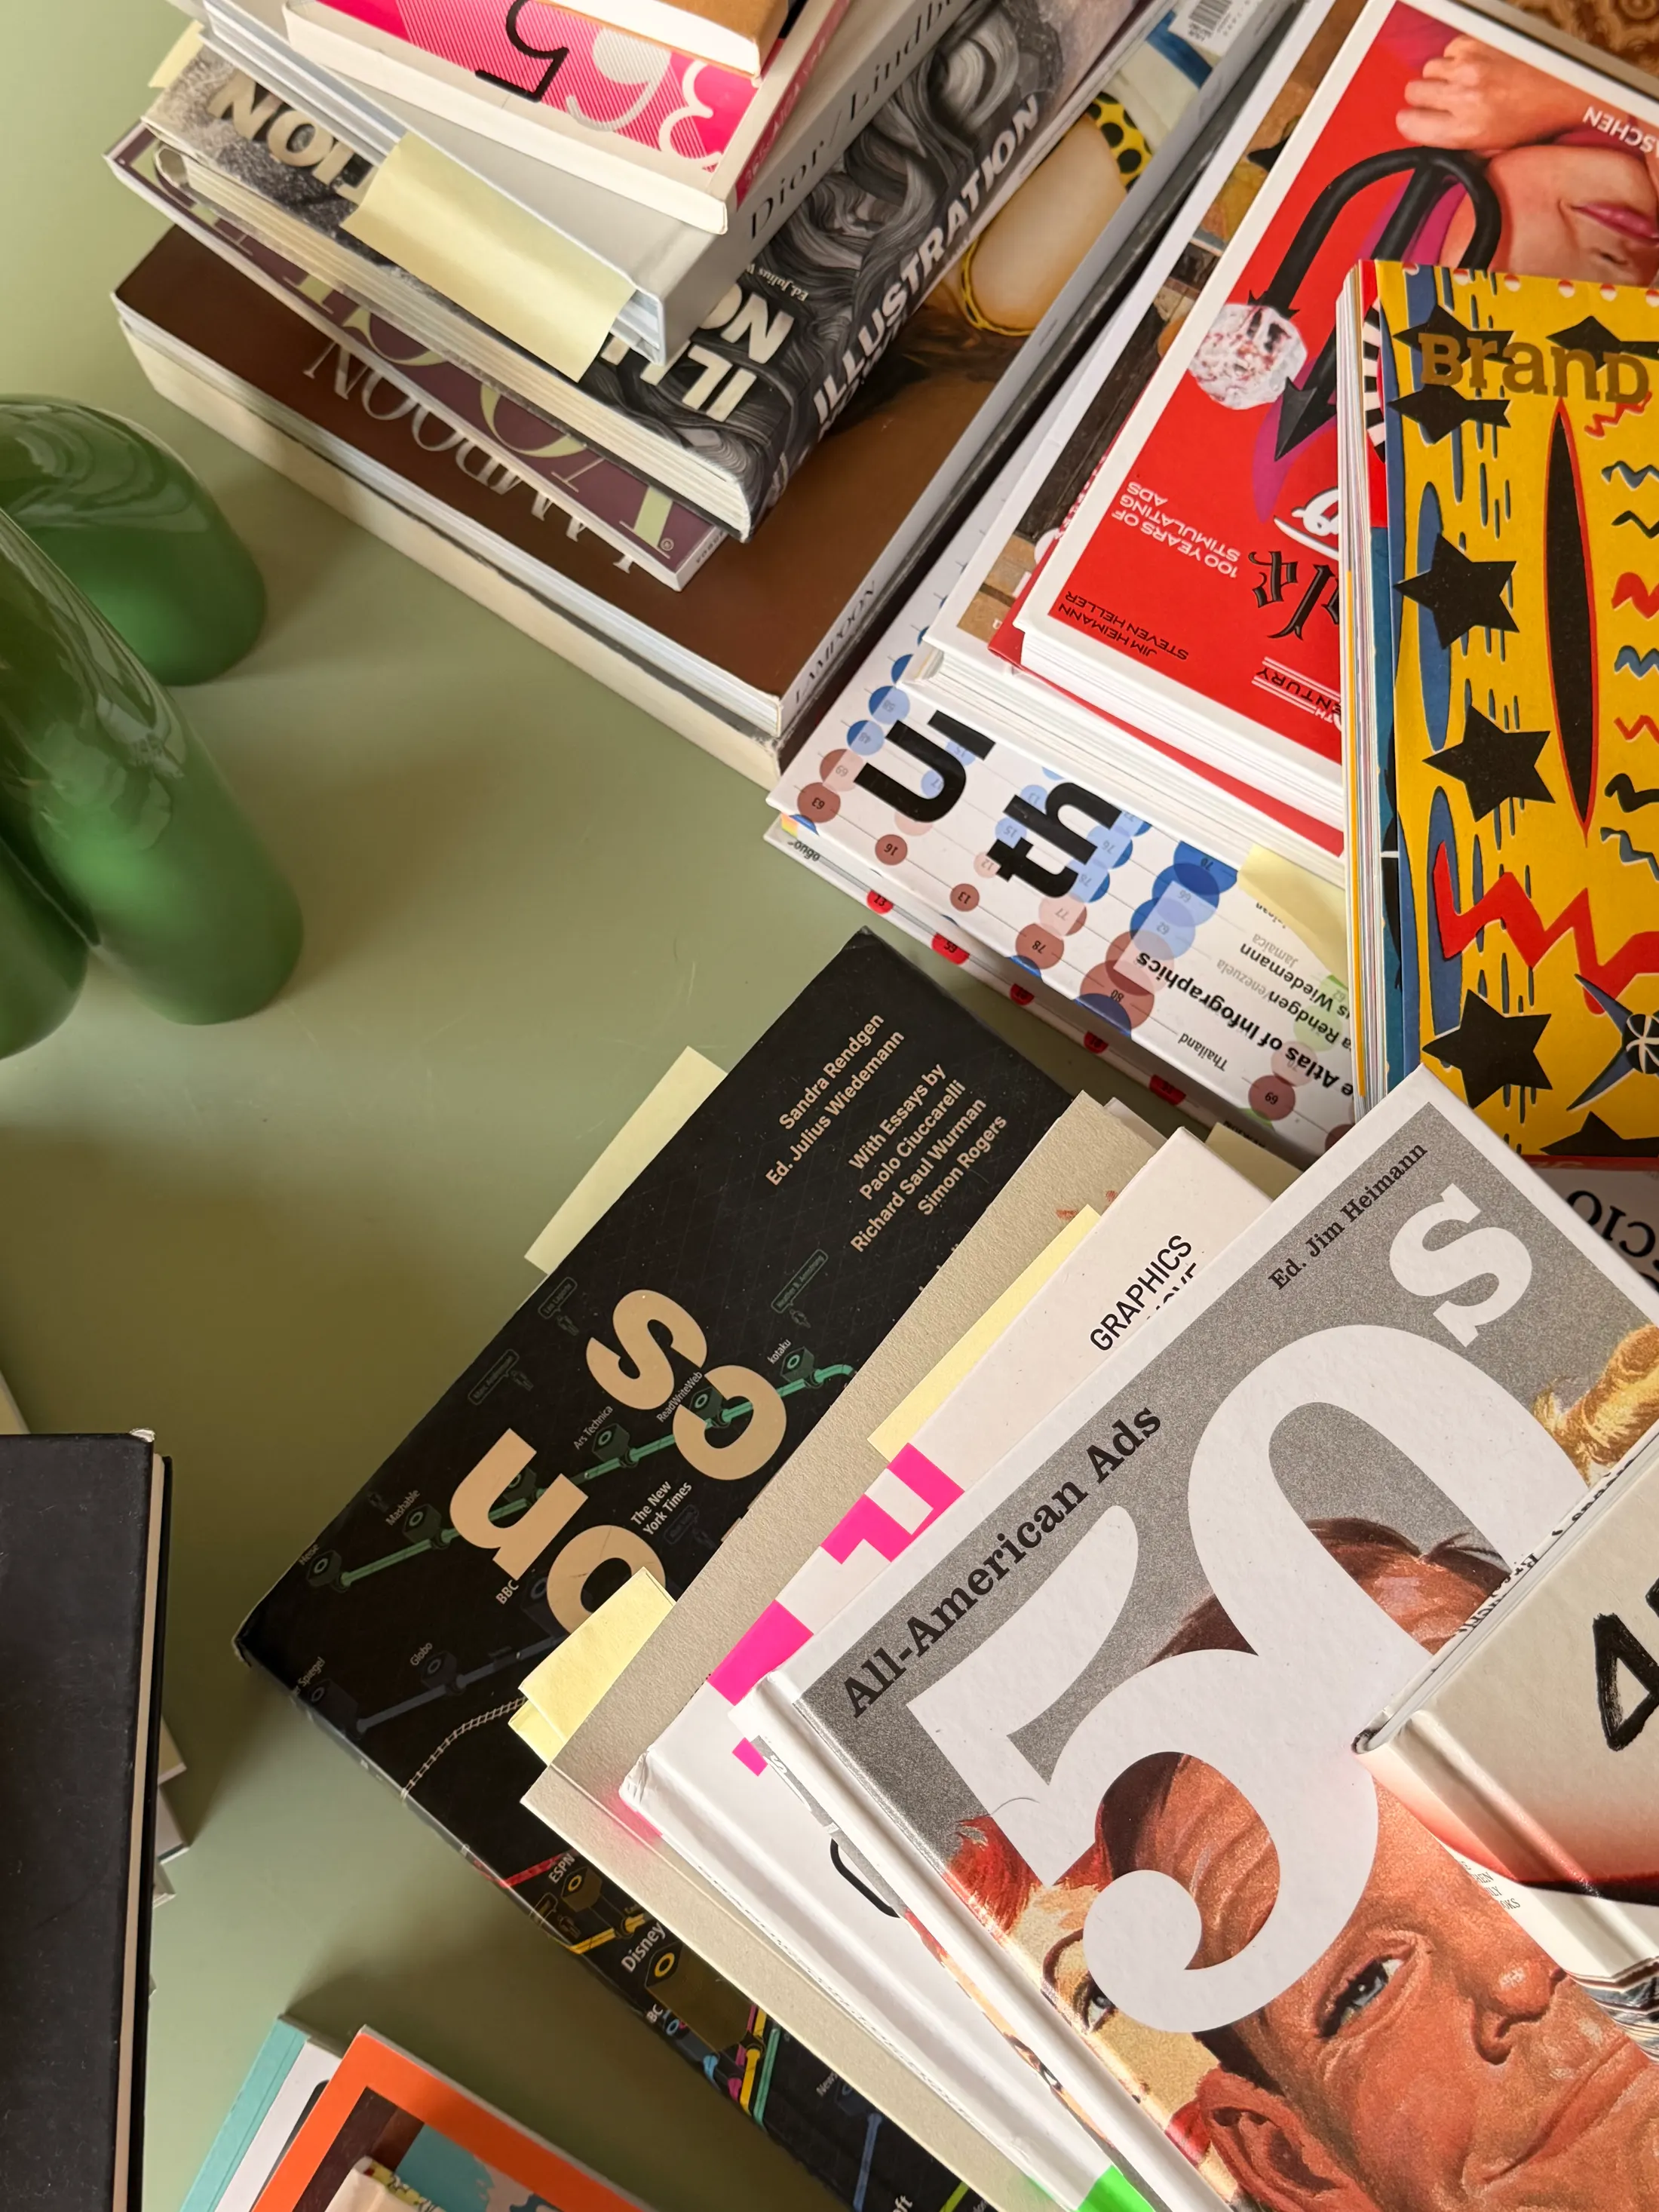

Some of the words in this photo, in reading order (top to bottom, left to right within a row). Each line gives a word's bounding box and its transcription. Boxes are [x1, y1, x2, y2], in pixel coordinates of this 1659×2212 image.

[750, 0, 949, 240] Dior/Lindb
[815, 97, 1040, 424] ILLUSTRATION
[1127, 483, 1168, 507] ADS
[1112, 510, 1139, 527] OF
[1119, 494, 1241, 563] STIMULATING
[1140, 522, 1201, 561] YEARS
[1204, 554, 1238, 578] 100
[1058, 603, 1130, 646] HEIMANN
[1065, 591, 1127, 629] HELLER
[1126, 622, 1190, 661] STEVEN
[1130, 640, 1158, 658] JIM
[834, 763, 849, 778] 69
[811, 796, 826, 811] 63
[786, 836, 822, 864] ongo
[883, 842, 898, 856] 16
[1003, 824, 1017, 838] 15
[1101, 839, 1116, 854] 76
[980, 857, 995, 870] 12
[1078, 873, 1092, 887] 78
[956, 890, 971, 904] 13
[1054, 906, 1069, 920] 77
[1177, 888, 1192, 903] 66
[1031, 939, 1046, 953] 78
[1155, 921, 1170, 935] 62
[1248, 931, 1300, 971] Jamaica
[1109, 988, 1124, 1003] 80
[1130, 946, 1264, 1042] Infographics
[1235, 940, 1337, 1013] Wiedemann
[1263, 987, 1343, 1046] Rendgen
[1178, 1033, 1228, 1072] Thailand
[1256, 1029, 1286, 1057] of
[779, 1077, 830, 1130] Sandra
[823, 1015, 885, 1079] Rendgen
[1280, 1045, 1342, 1093] Atlas
[765, 1160, 794, 1186] Ed.
[790, 1115, 832, 1161] Julius
[823, 1032, 905, 1116] Wiedemann
[848, 1134, 887, 1170] With
[879, 1085, 929, 1136] Essays
[921, 1063, 947, 1088] by
[1263, 1091, 1279, 1105] 69
[859, 1157, 901, 1201] Paolo
[896, 1079, 967, 1158] Ciuccarelli
[850, 1191, 906, 1253] Richard
[899, 1157, 935, 1195] Saul
[926, 1100, 987, 1161] Wurman
[918, 1167, 964, 1216] Simon
[956, 1116, 1007, 1170] Rogers
[1268, 1255, 1309, 1290] Ed.
[1305, 1222, 1345, 1258] Jim
[1340, 1142, 1428, 1221] Heimann
[1090, 1235, 1192, 1351] GRAPHICS
[767, 1339, 792, 1365] kotaku
[655, 1367, 707, 1425] ReadWriteWeb
[573, 1435, 588, 1451] Ars
[583, 1406, 614, 1437] Technica
[385, 1486, 421, 1527] Mashable
[630, 1505, 653, 1525] The
[647, 1481, 672, 1507] New
[642, 1511, 668, 1536] York
[662, 1482, 692, 1513] Times
[841, 1459, 1091, 1717] All-American
[1091, 1407, 1161, 1483] Ads
[495, 1579, 520, 1605] BBC
[296, 1655, 328, 1689] Spiegel
[406, 1638, 437, 1670] Globo
[545, 1851, 578, 1885] ESPN
[617, 1919, 673, 1977] Disney
[646, 2003, 664, 2025] BC
